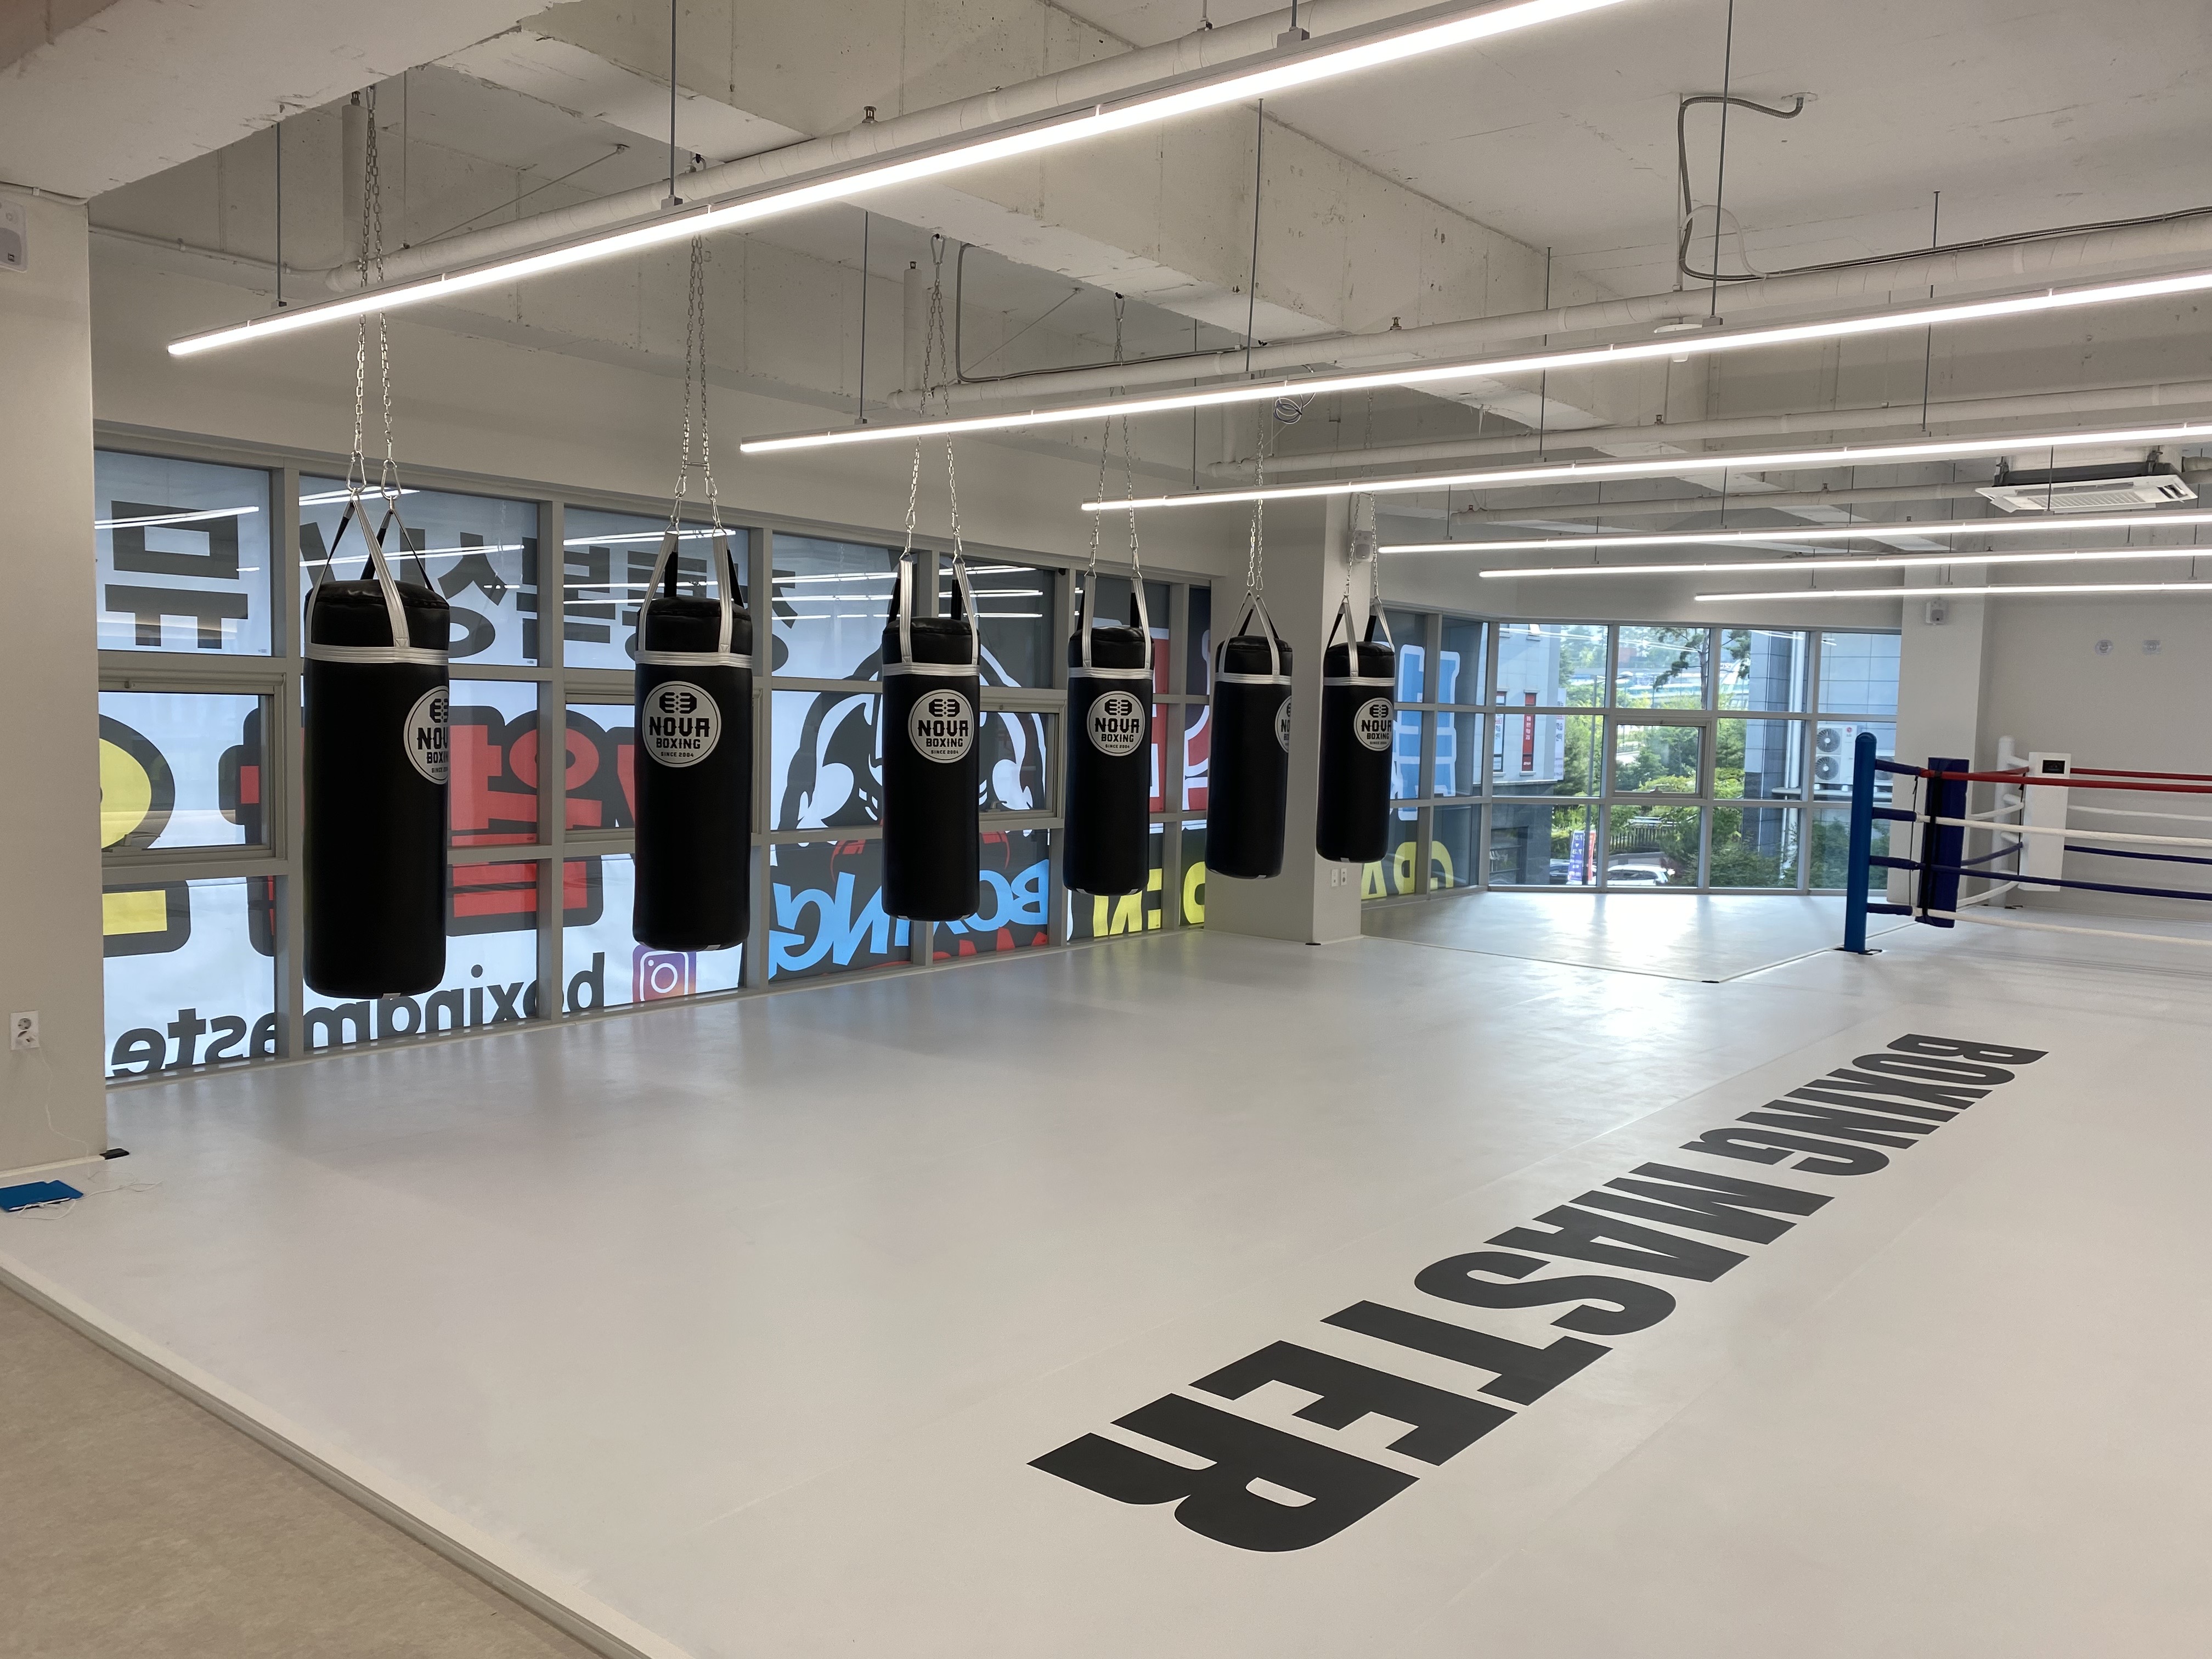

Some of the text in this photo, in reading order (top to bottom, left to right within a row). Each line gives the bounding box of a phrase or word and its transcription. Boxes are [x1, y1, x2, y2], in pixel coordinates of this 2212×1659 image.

[649, 716, 710, 737] NOVA
[917, 720, 968, 737] NOVA
[1095, 717, 1140, 733] NOVA
[656, 738, 701, 749] BOXING
[926, 738, 963, 747] BOXING
[1101, 733, 1134, 742] BOXING
[1026, 1034, 2050, 1553] BOXING MASTER
